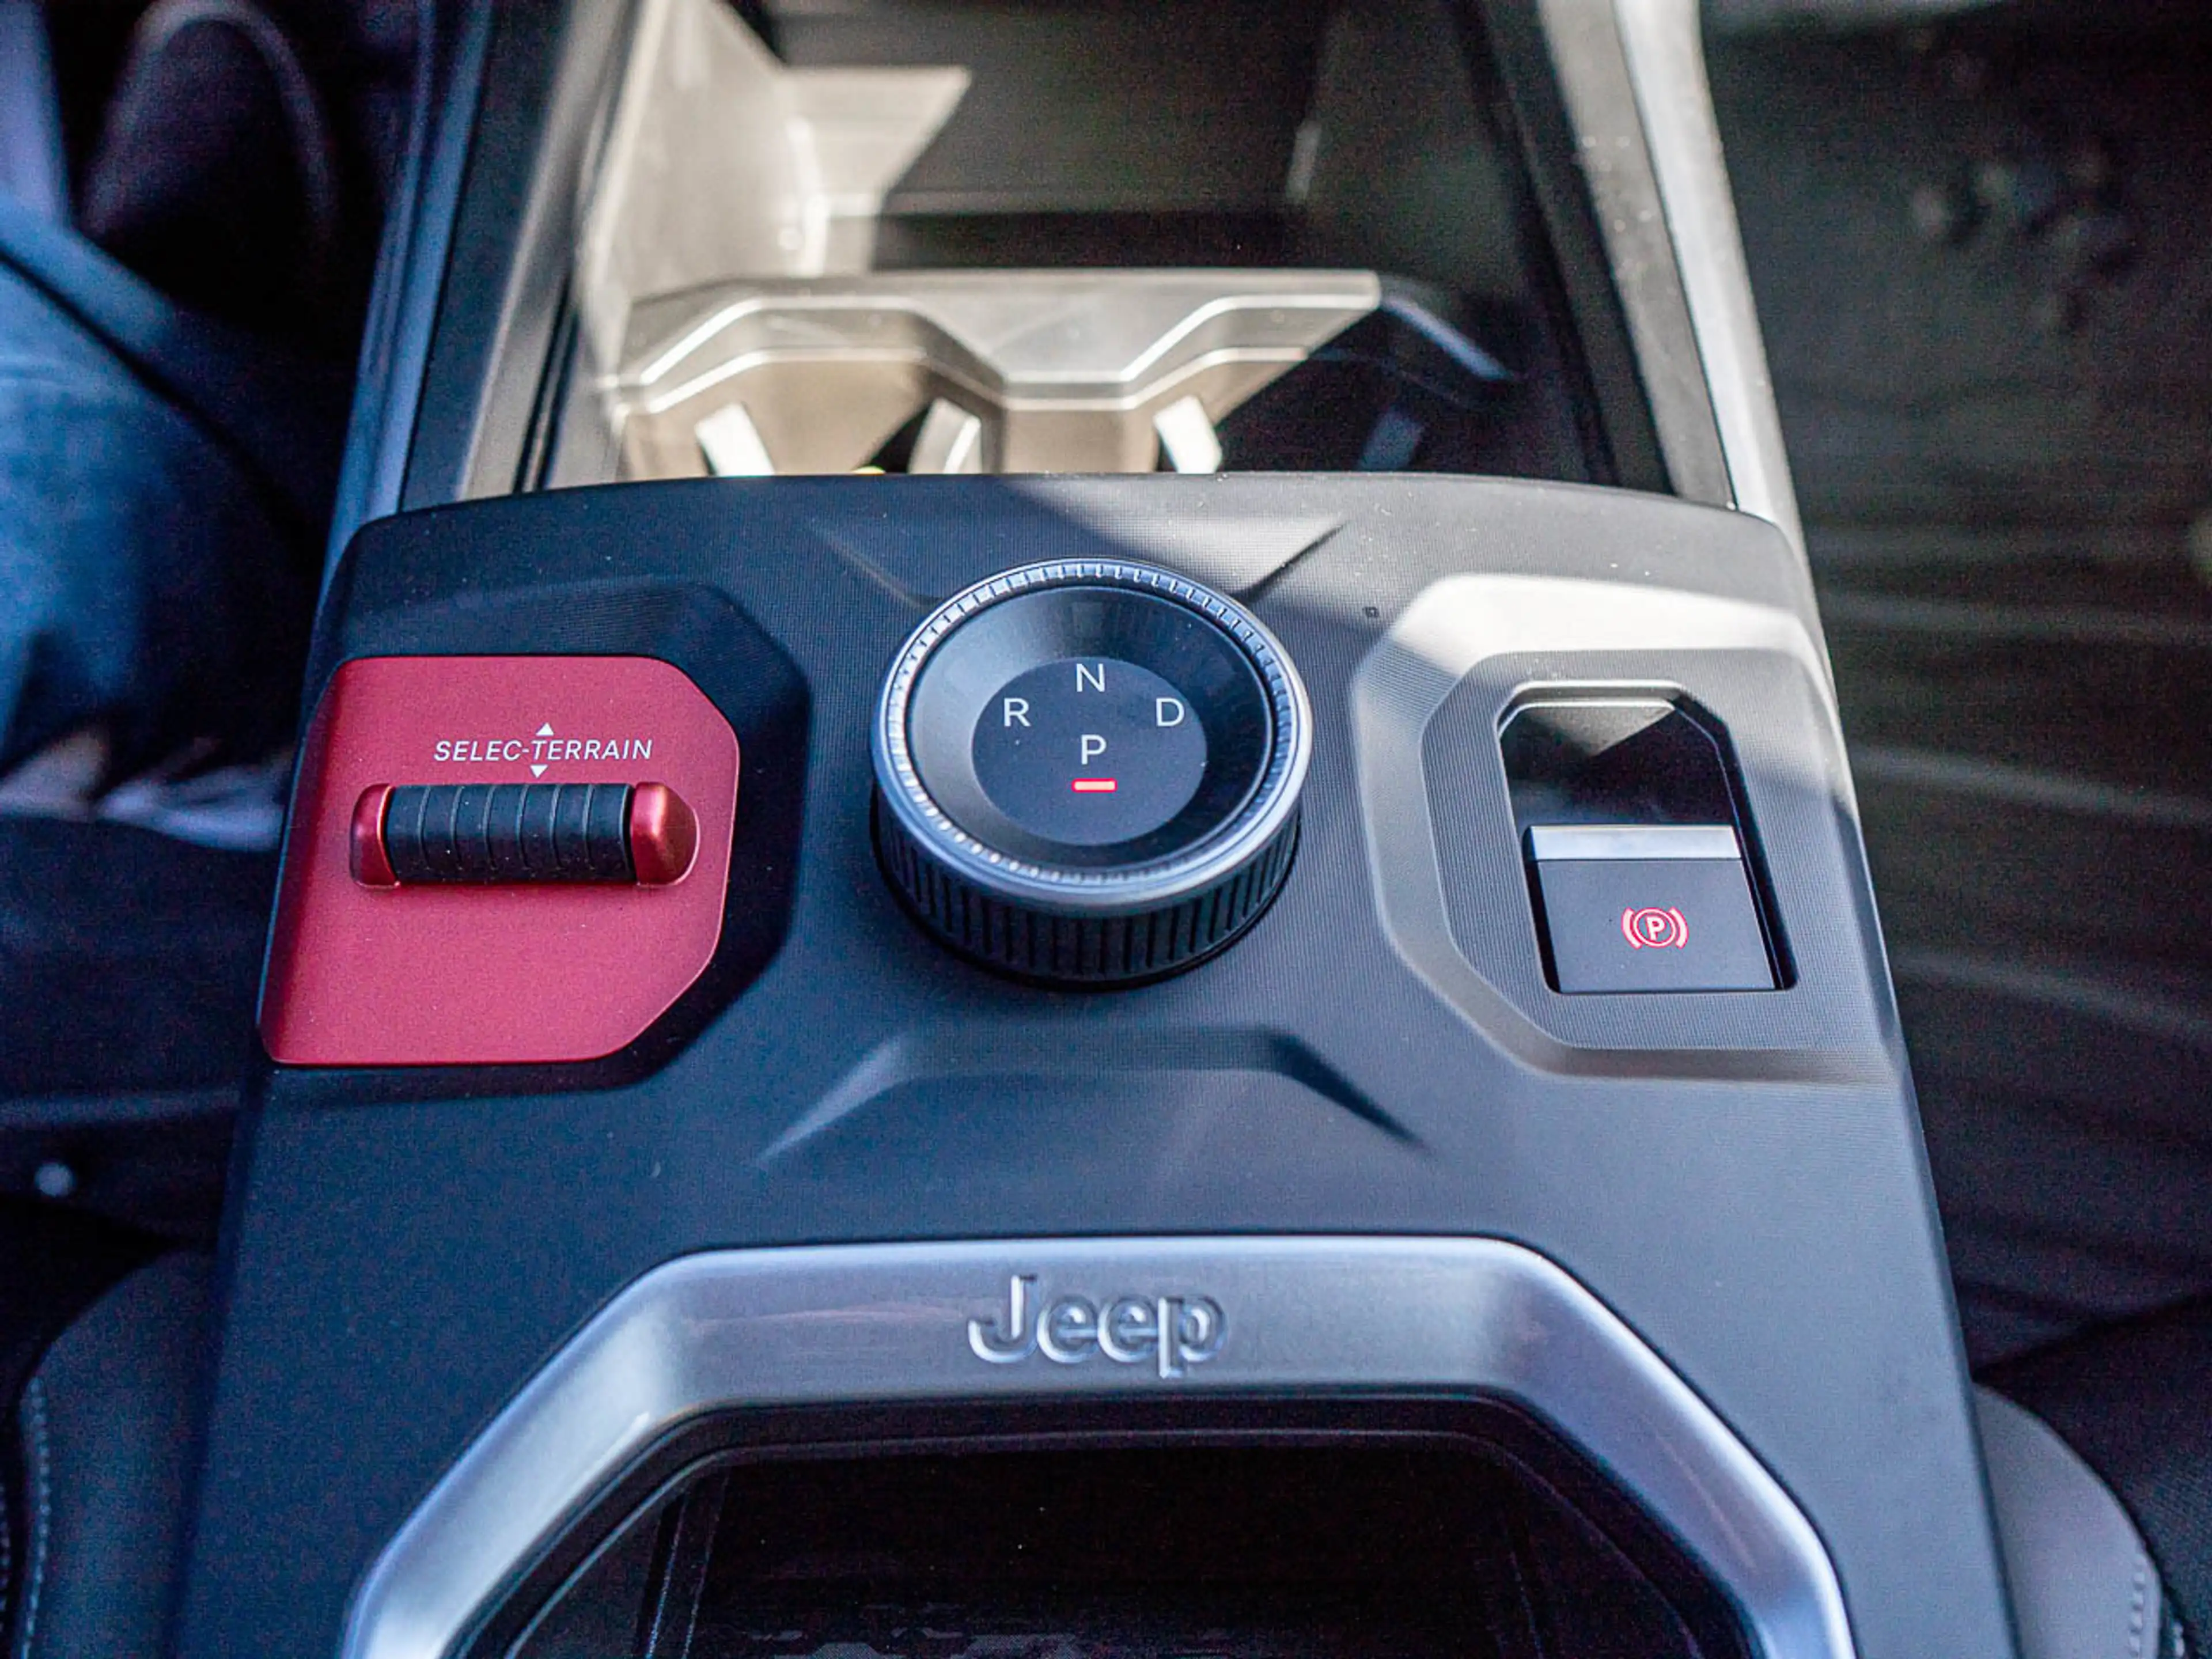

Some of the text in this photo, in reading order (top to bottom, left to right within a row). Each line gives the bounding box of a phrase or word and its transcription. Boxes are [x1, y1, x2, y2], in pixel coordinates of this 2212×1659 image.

[1076, 664, 1105, 692] N
[1004, 698, 1031, 727] R
[1156, 698, 1185, 727] D
[434, 740, 652, 761] SELEC-TERRAIN
[1081, 734, 1107, 765] P
[968, 1274, 1229, 1378] Jeep
